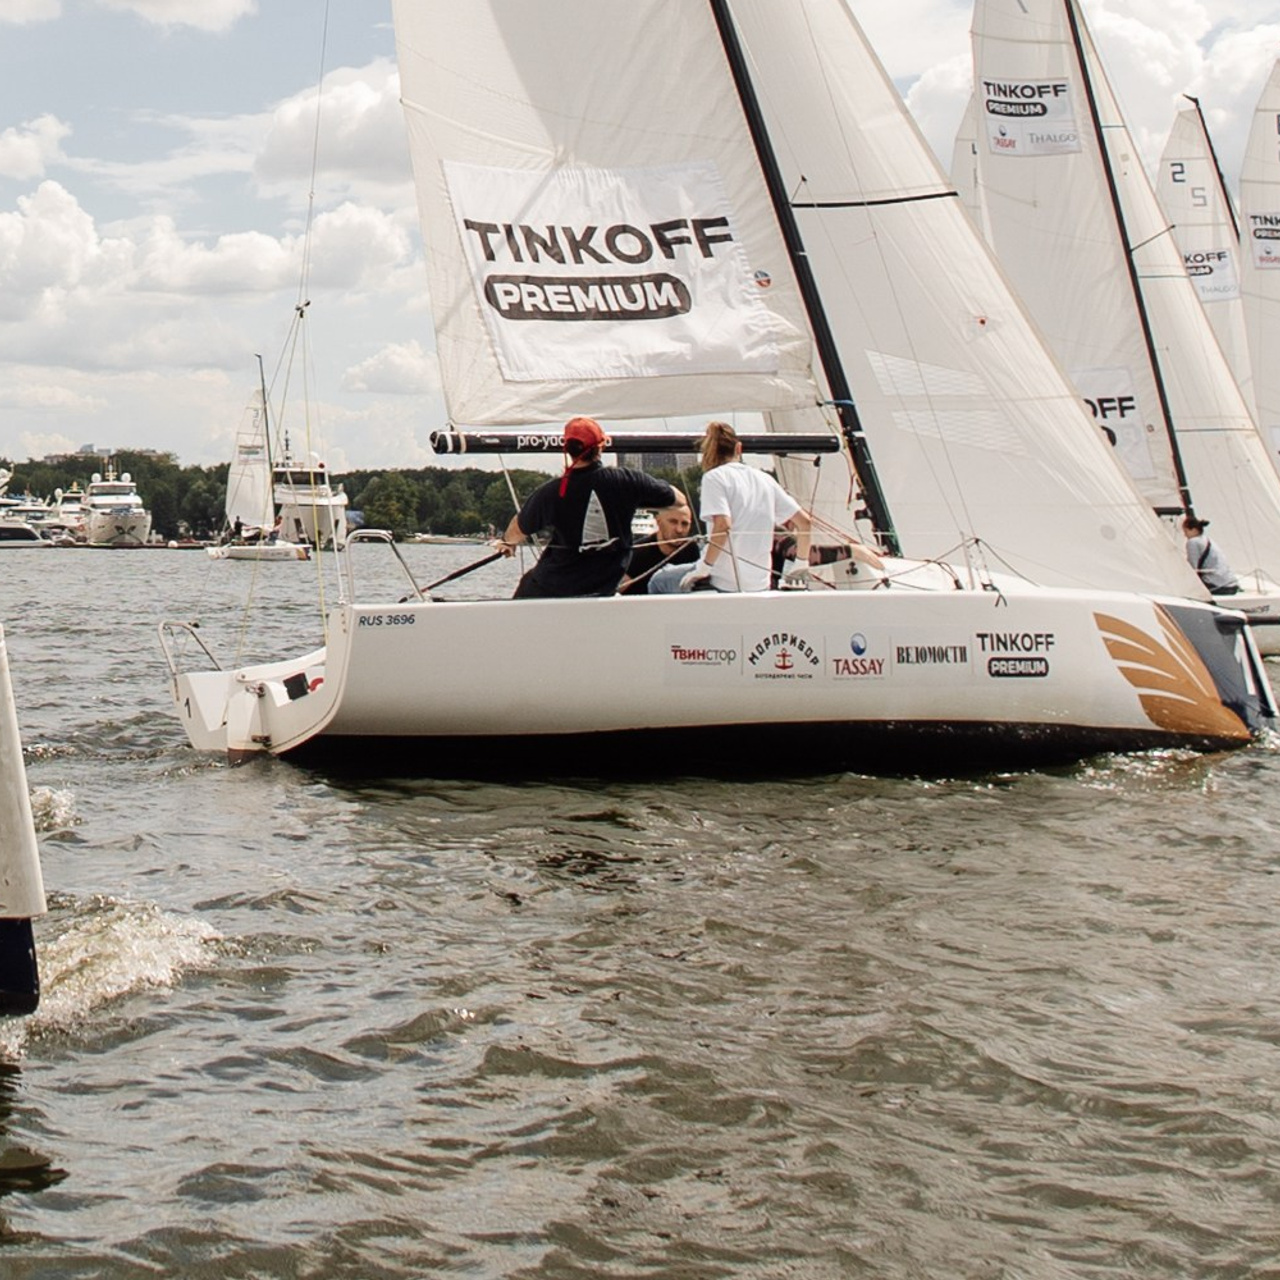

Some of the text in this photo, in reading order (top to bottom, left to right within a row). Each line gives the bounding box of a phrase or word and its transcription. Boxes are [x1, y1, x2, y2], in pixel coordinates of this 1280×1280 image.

[983, 81, 1067, 99] TINKOFF
[1170, 162, 1186, 183] 2
[463, 216, 733, 265] TINKOFF
[493, 281, 682, 314] PREMIUM
[359, 614, 416, 626] RUS 3696
[976, 632, 1055, 652] TINKOFF
[833, 658, 885, 675] TASSAY
[989, 660, 1047, 675] PREMIUM
